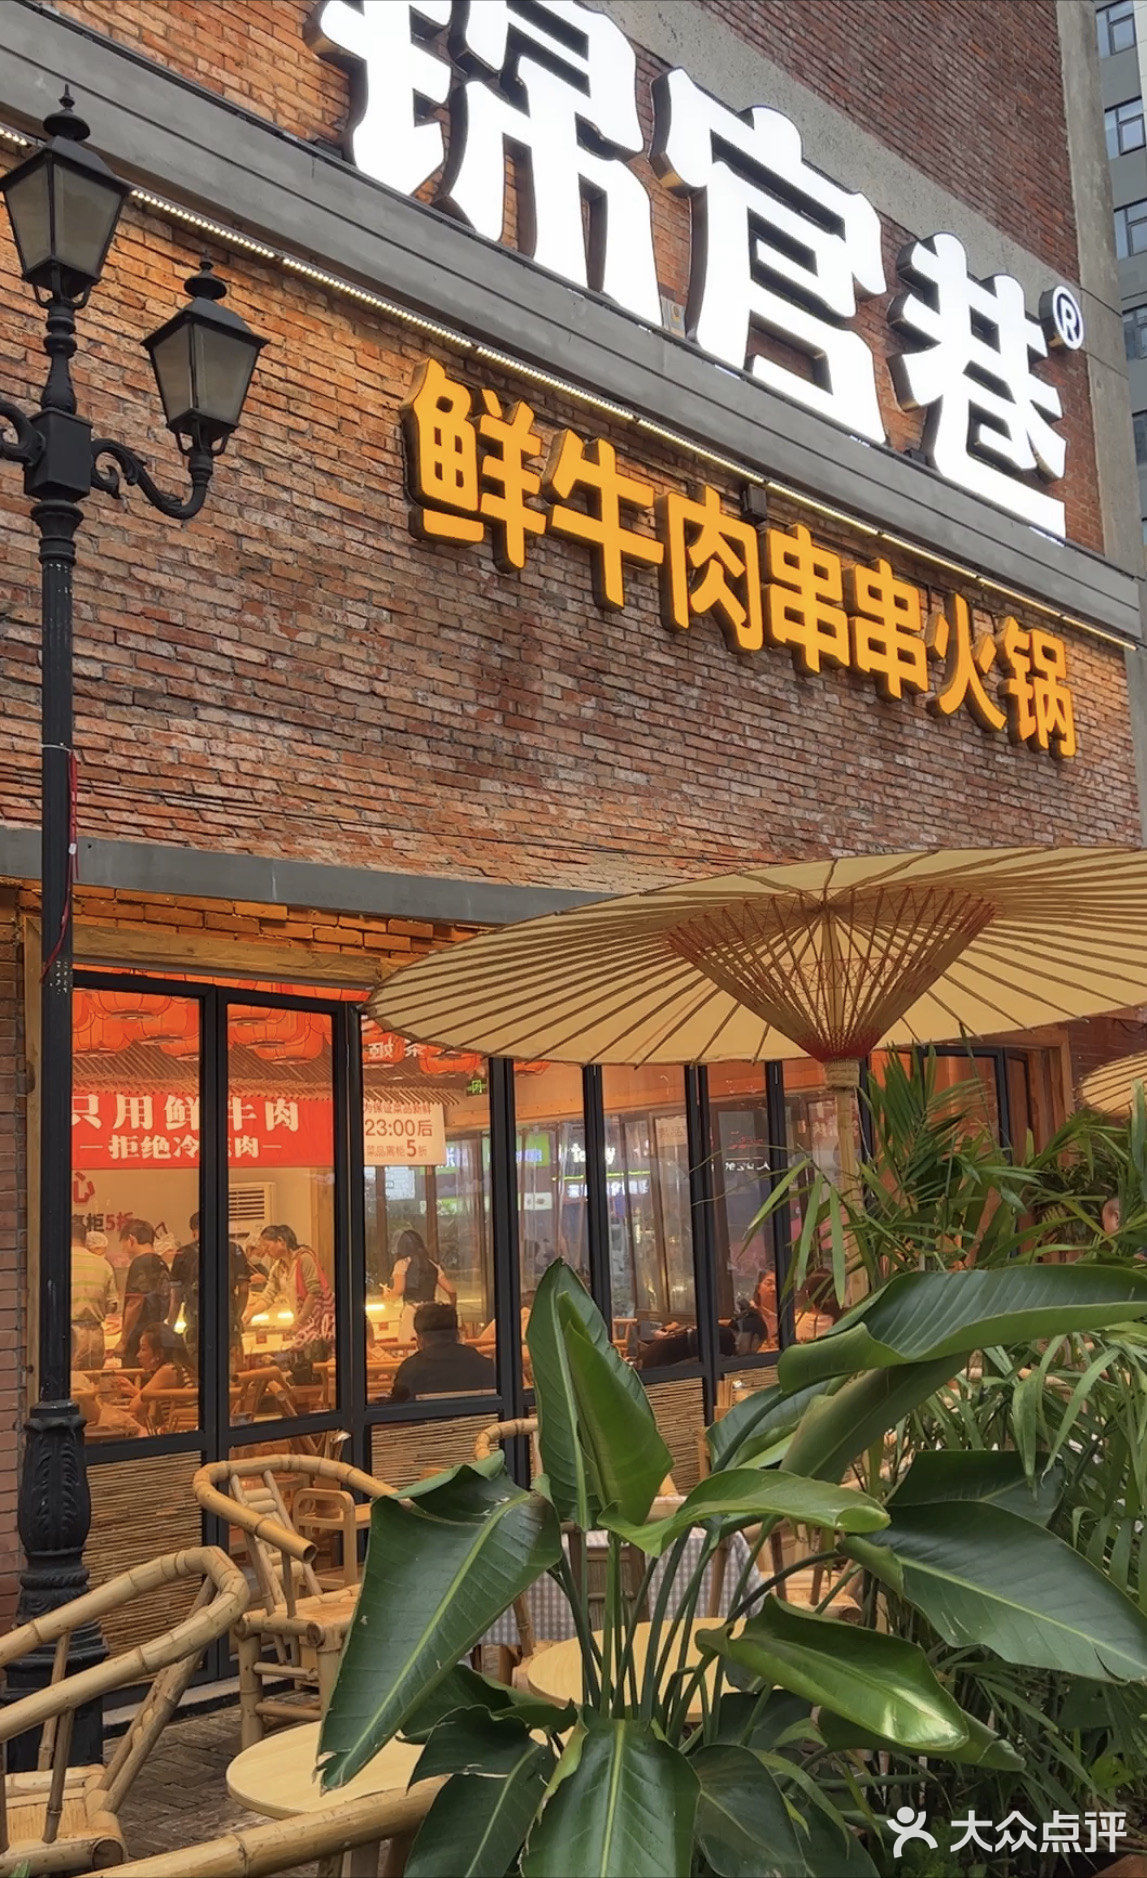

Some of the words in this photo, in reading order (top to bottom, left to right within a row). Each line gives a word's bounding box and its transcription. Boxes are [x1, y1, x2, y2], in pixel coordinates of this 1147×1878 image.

[408, 360, 1076, 757] 鲜牛肉串串火锅
[365, 1119, 432, 1136] 23:00后
[108, 1134, 260, 1159] 拒绝冷肉
